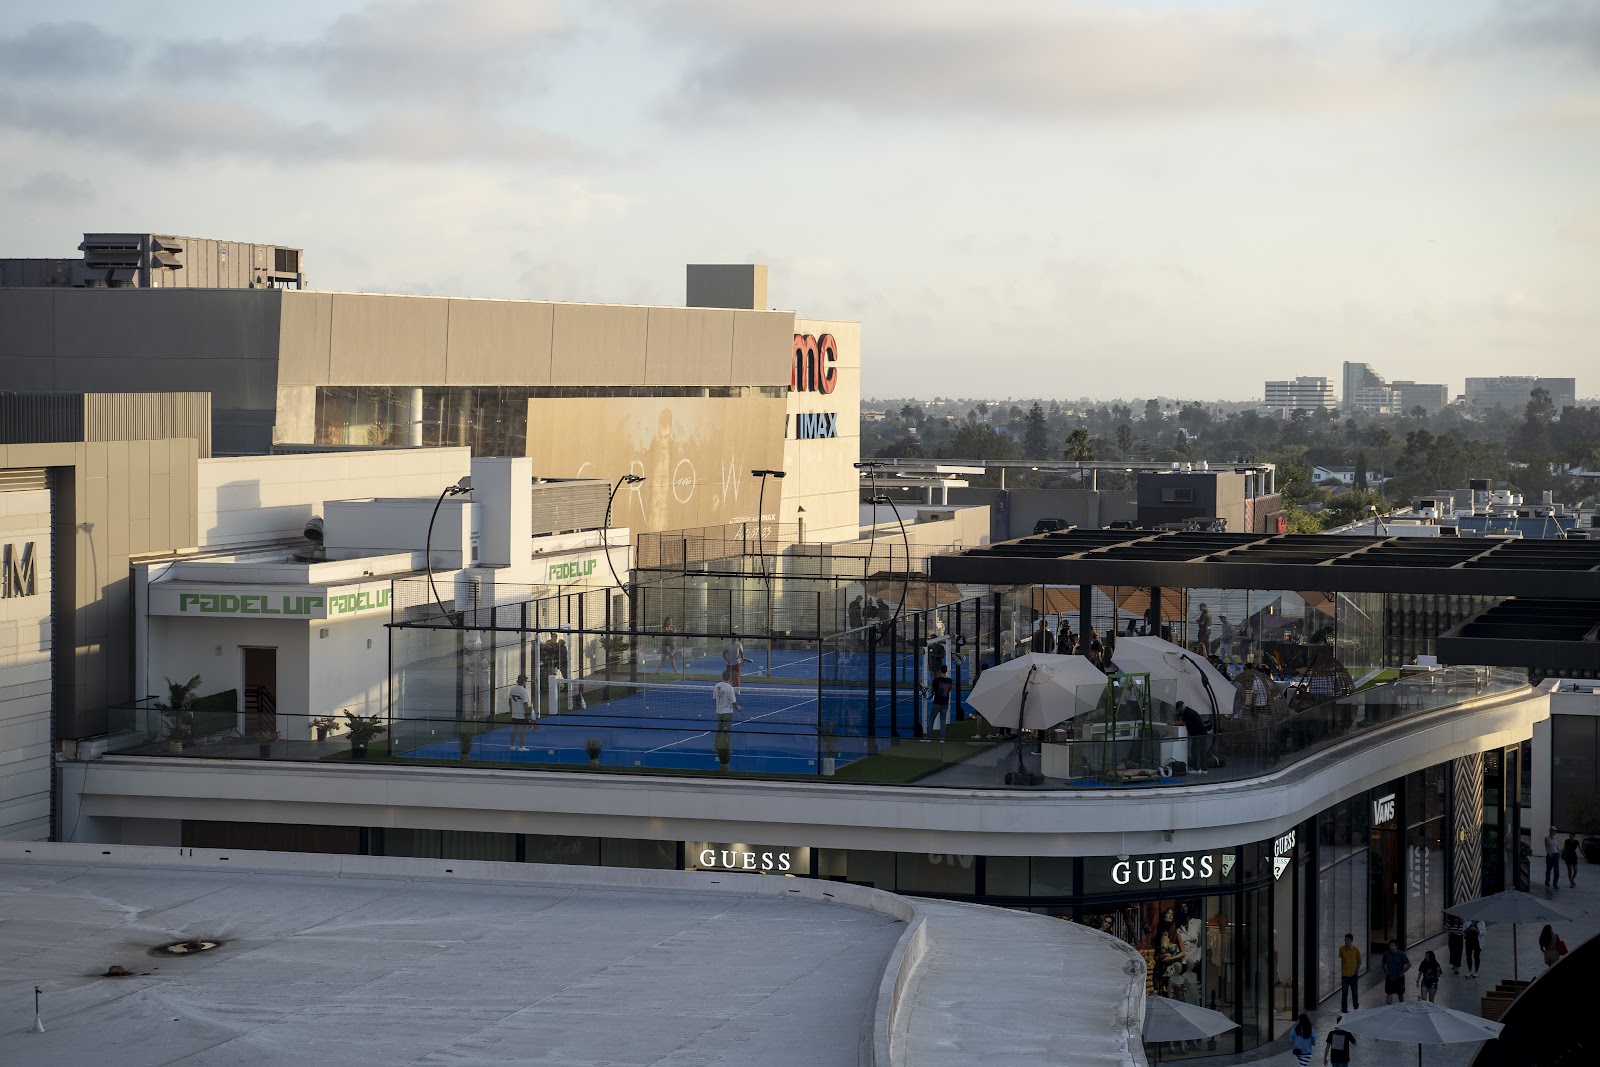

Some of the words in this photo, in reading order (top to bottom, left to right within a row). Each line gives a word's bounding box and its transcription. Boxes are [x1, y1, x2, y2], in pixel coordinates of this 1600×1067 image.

[789, 333, 838, 395] mc
[797, 413, 838, 440] IMAX
[1, 541, 39, 598] M
[1373, 793, 1396, 826] VANS
[1274, 830, 1296, 857] GUESS
[700, 849, 791, 871] GUESS
[1112, 855, 1213, 885] GUESS
